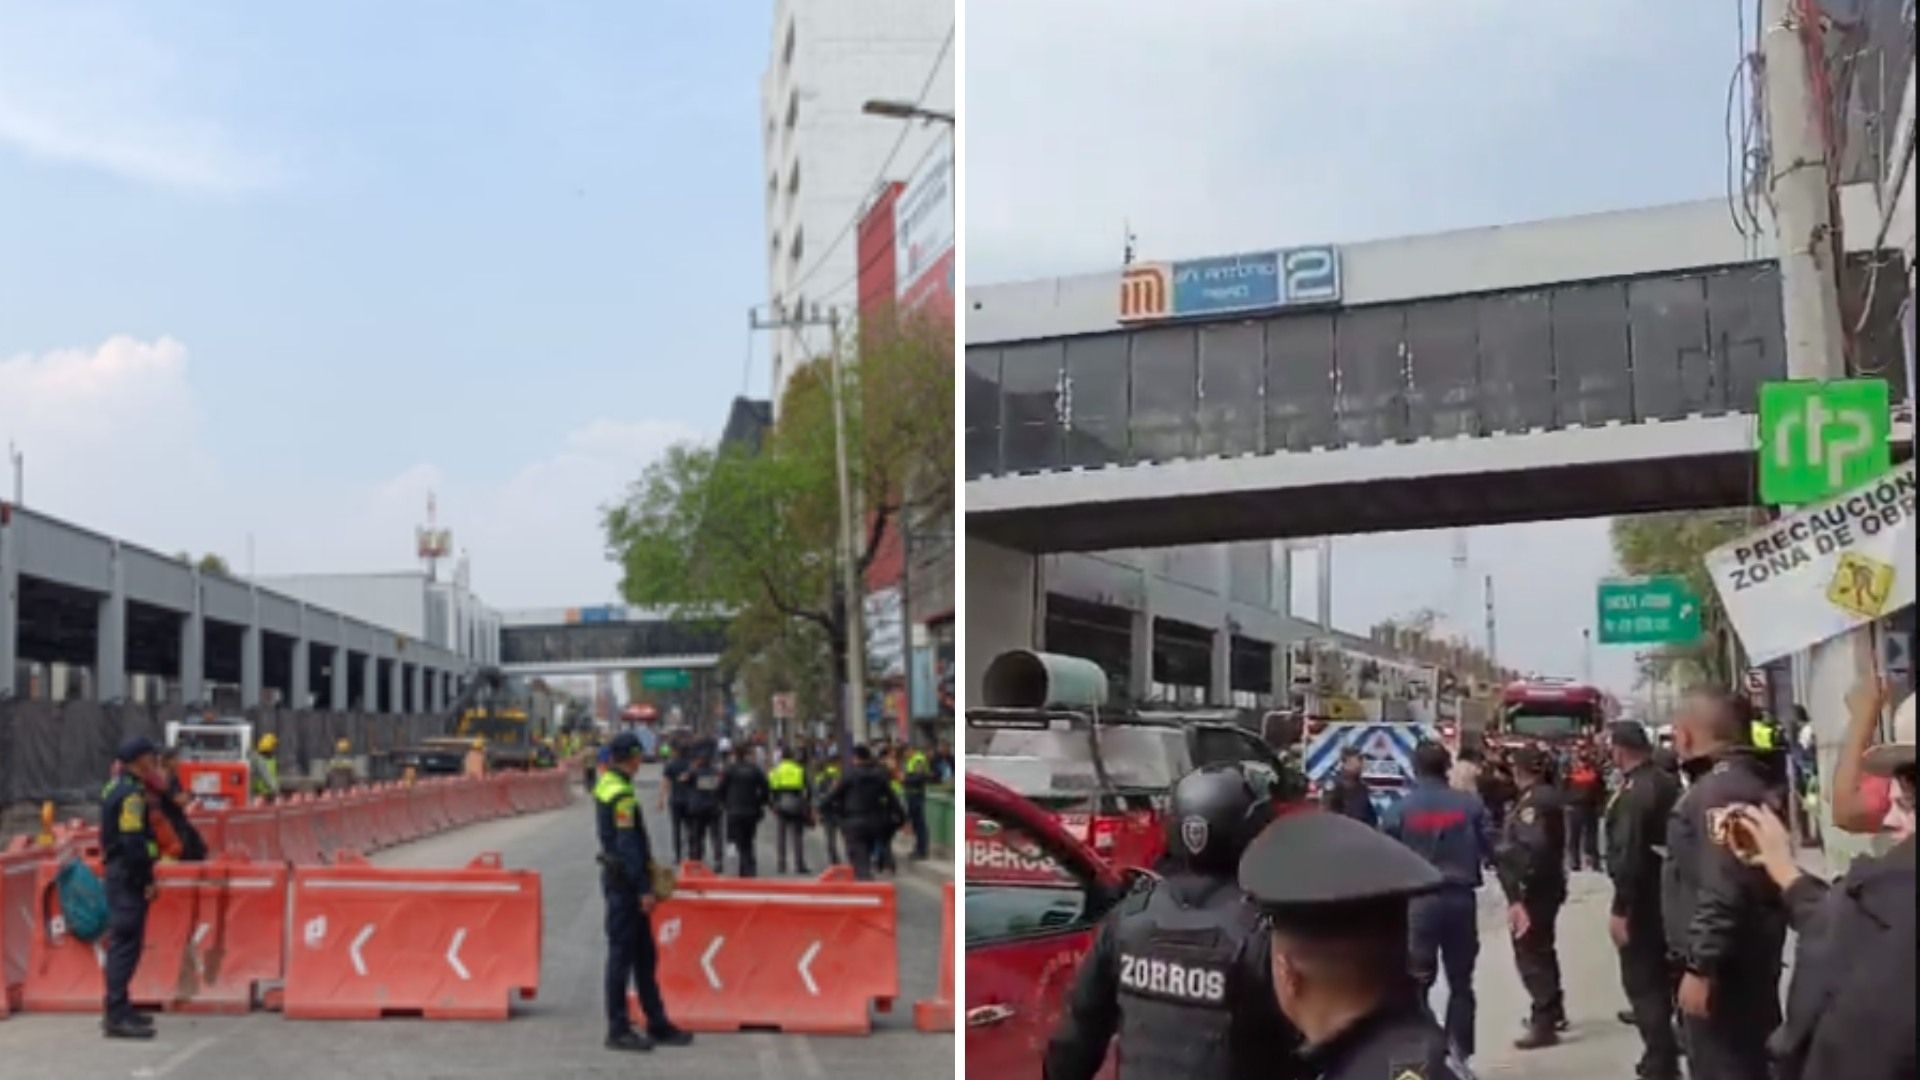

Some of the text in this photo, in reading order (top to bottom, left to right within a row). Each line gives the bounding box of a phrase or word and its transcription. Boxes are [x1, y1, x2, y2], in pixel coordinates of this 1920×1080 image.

[1286, 250, 1334, 299] 2
[1734, 470, 1915, 566] PRECAUCIÓN
[1728, 545, 1812, 591] ZONA
[1815, 522, 1855, 555] DE
[1120, 954, 1226, 1000] ZORROS
